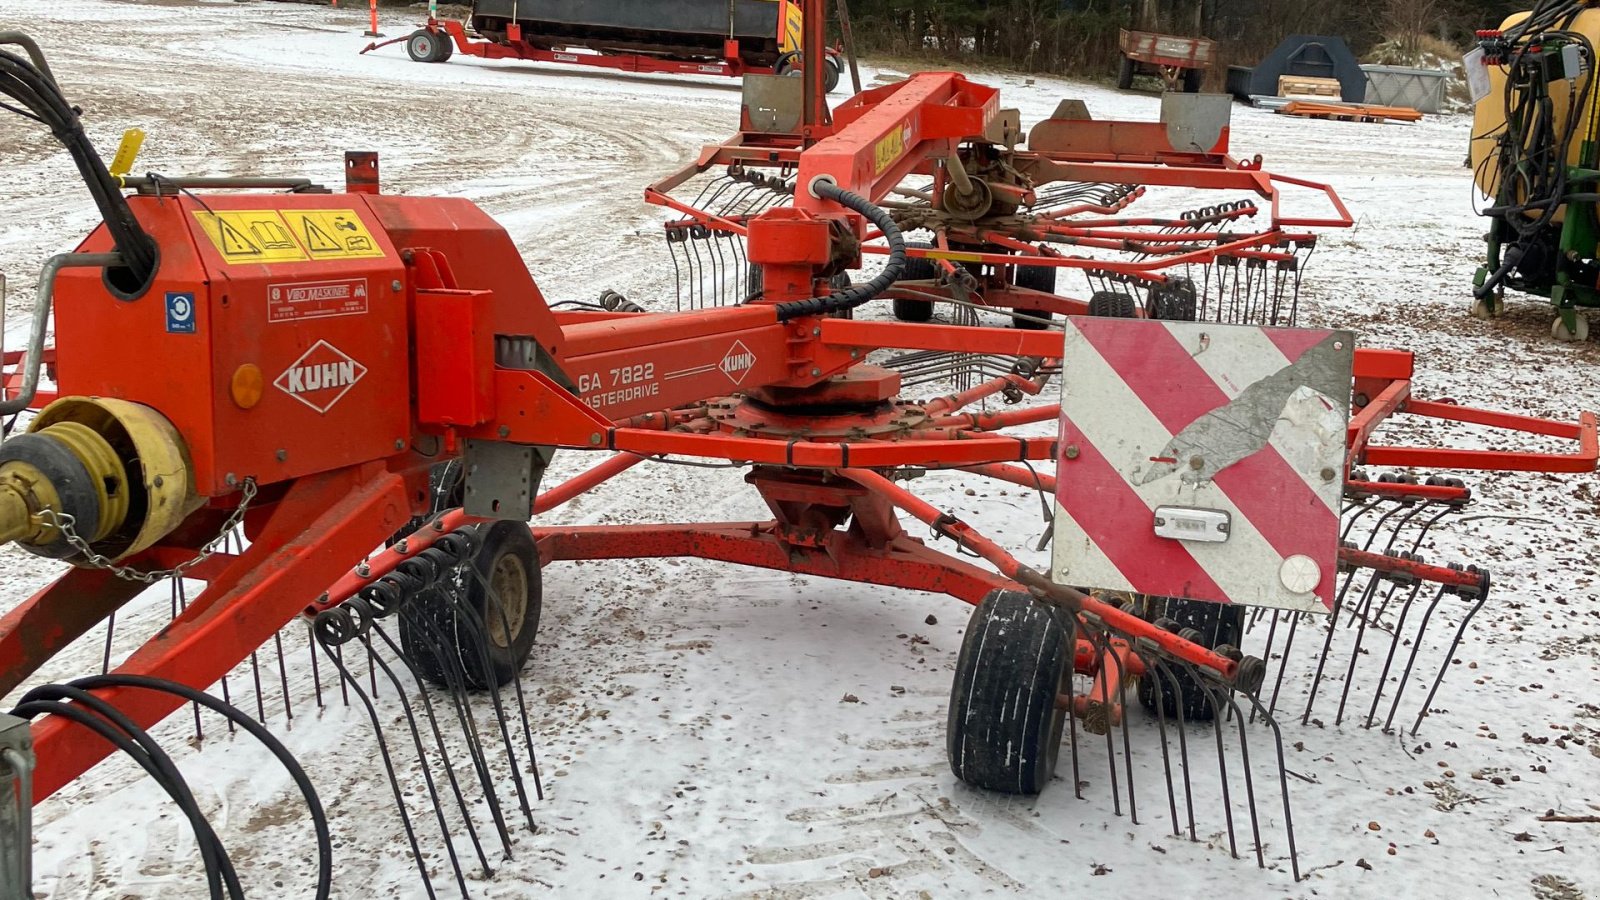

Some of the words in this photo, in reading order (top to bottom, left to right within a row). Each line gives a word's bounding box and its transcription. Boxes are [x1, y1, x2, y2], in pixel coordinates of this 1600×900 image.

[288, 361, 355, 393] KUHN
[724, 352, 752, 373] KUHN
[578, 372, 602, 393] GA
[609, 362, 655, 387] 7822
[580, 382, 659, 409] ASTERDRIVE
